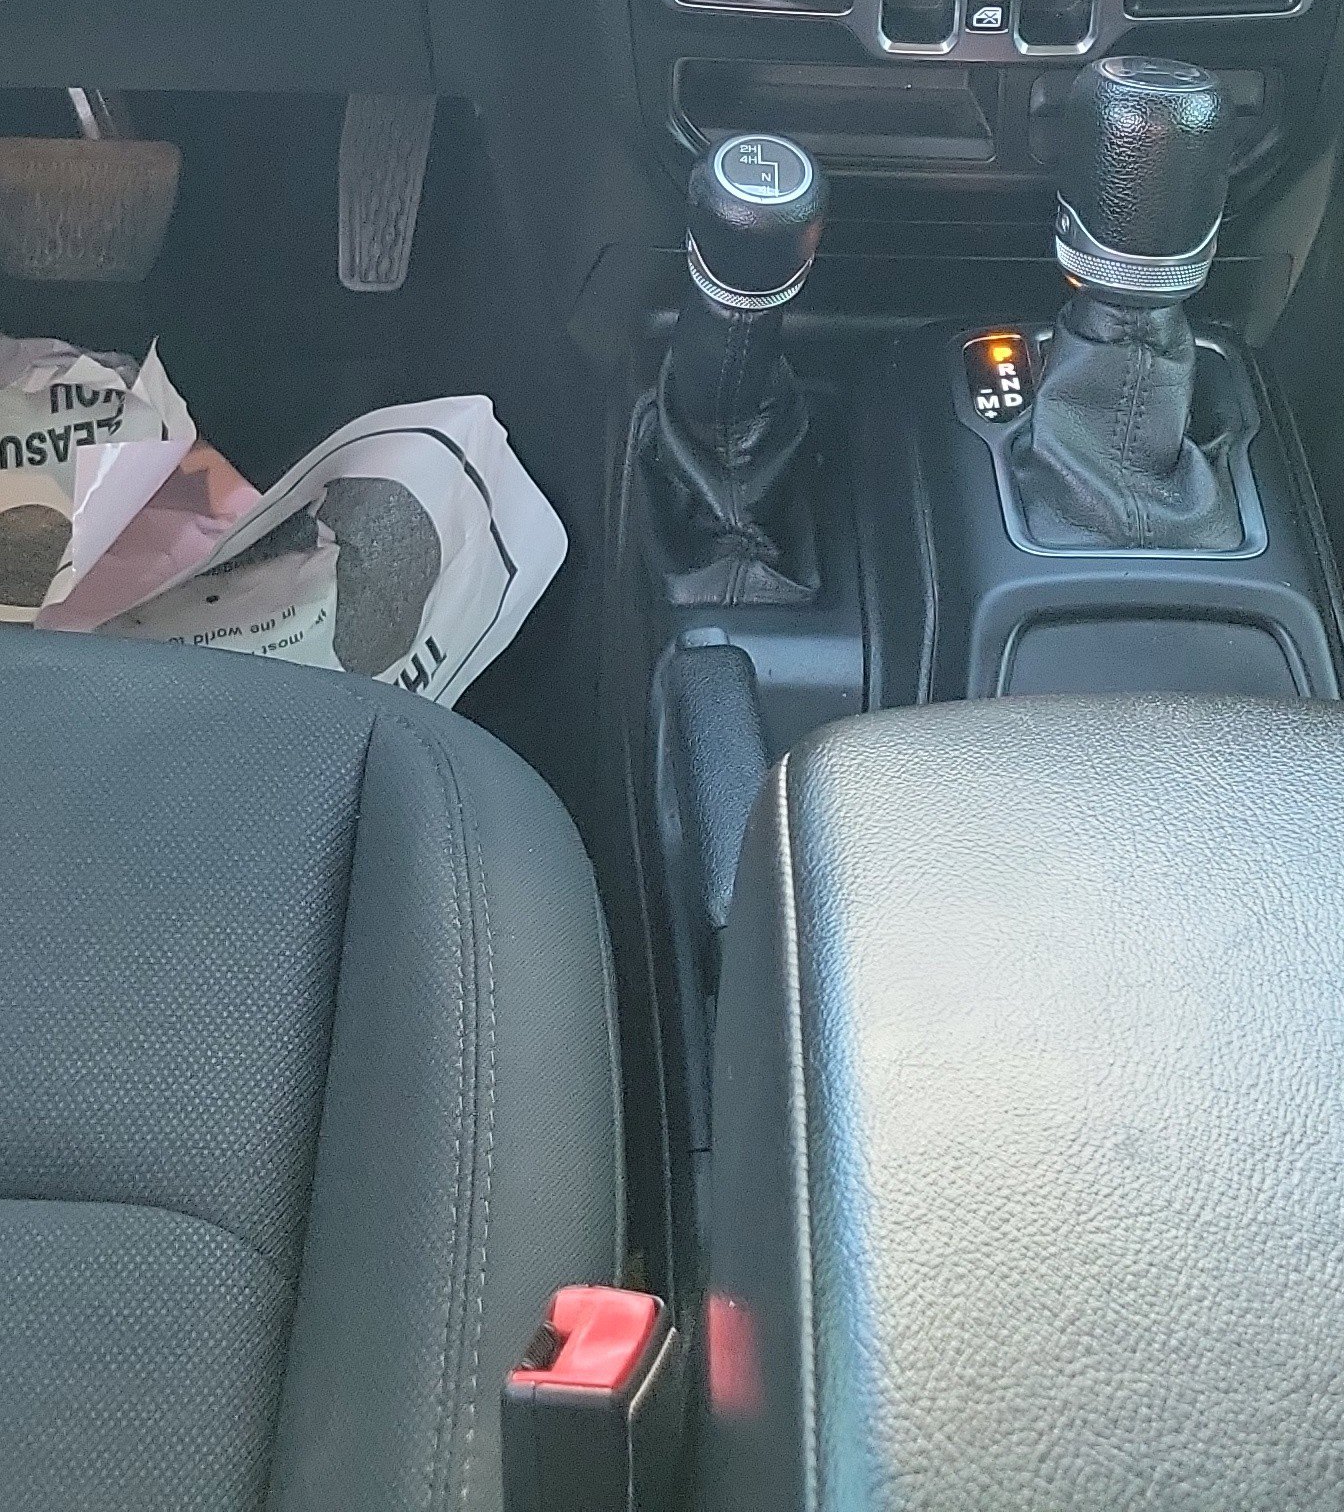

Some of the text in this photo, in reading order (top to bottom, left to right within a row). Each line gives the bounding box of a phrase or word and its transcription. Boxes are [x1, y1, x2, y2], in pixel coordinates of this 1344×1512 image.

[739, 144, 757, 153] 2H
[739, 155, 757, 165] 4H
[761, 172, 771, 182] N
[993, 347, 1012, 361] P
[998, 363, 1016, 376] R
[1001, 377, 1021, 391] N
[977, 395, 1000, 409] M
[1004, 393, 1023, 407] D
[262, 631, 304, 654] most
